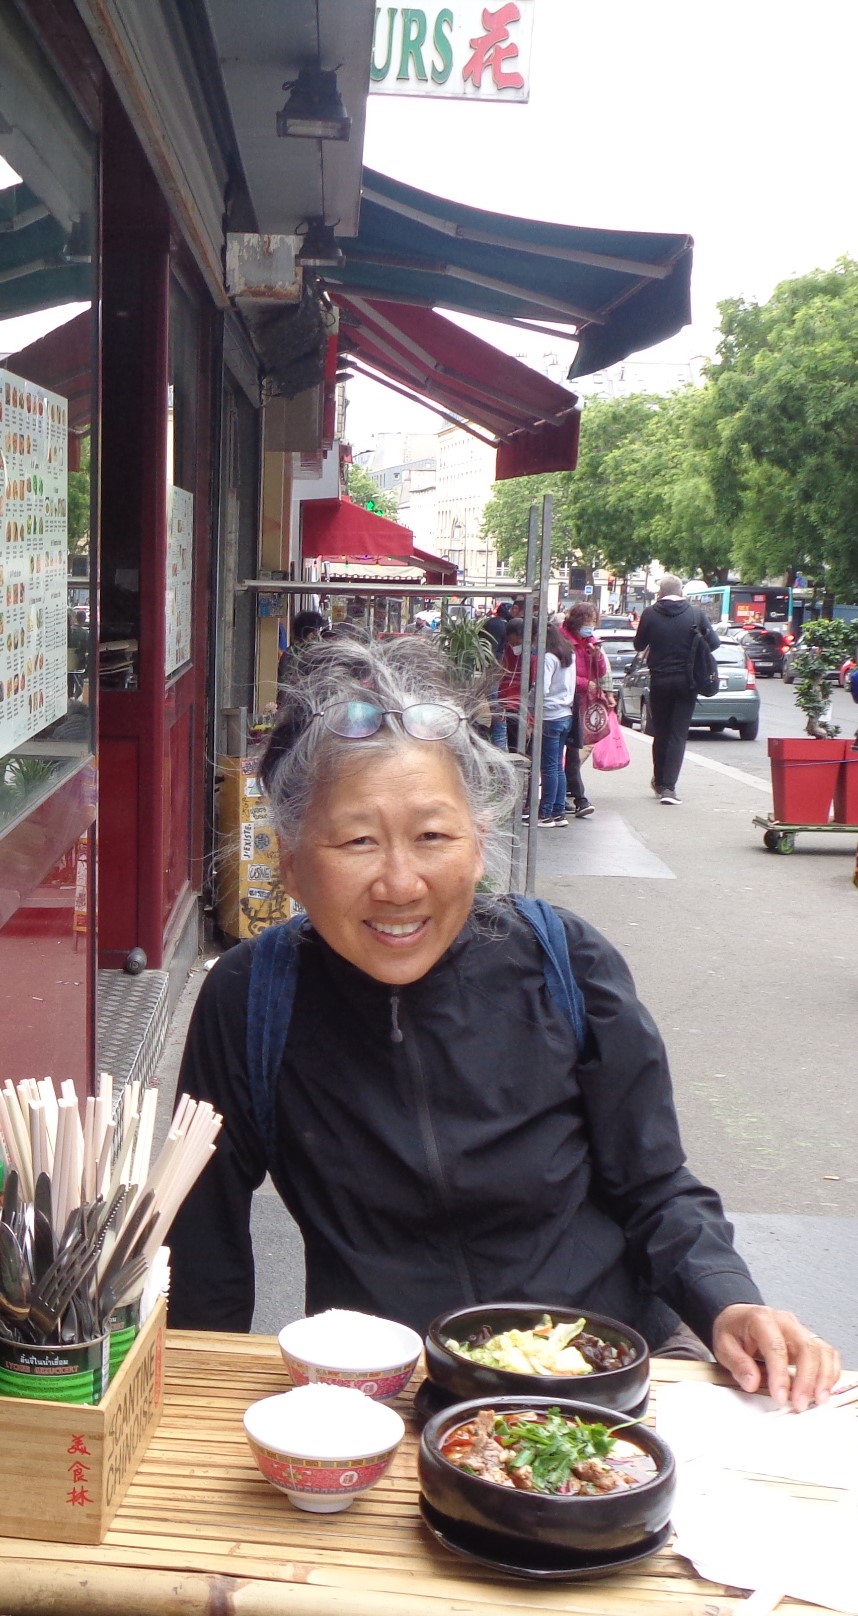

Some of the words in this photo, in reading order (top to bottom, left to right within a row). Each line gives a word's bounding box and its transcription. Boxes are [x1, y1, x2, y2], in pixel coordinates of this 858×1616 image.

[370, 8, 454, 84] URS
[463, 2, 524, 90] 花
[115, 1342, 155, 1446] CANTINE
[66, 1434, 94, 1507] 美食林
[105, 1386, 154, 1506] CHINOISE
